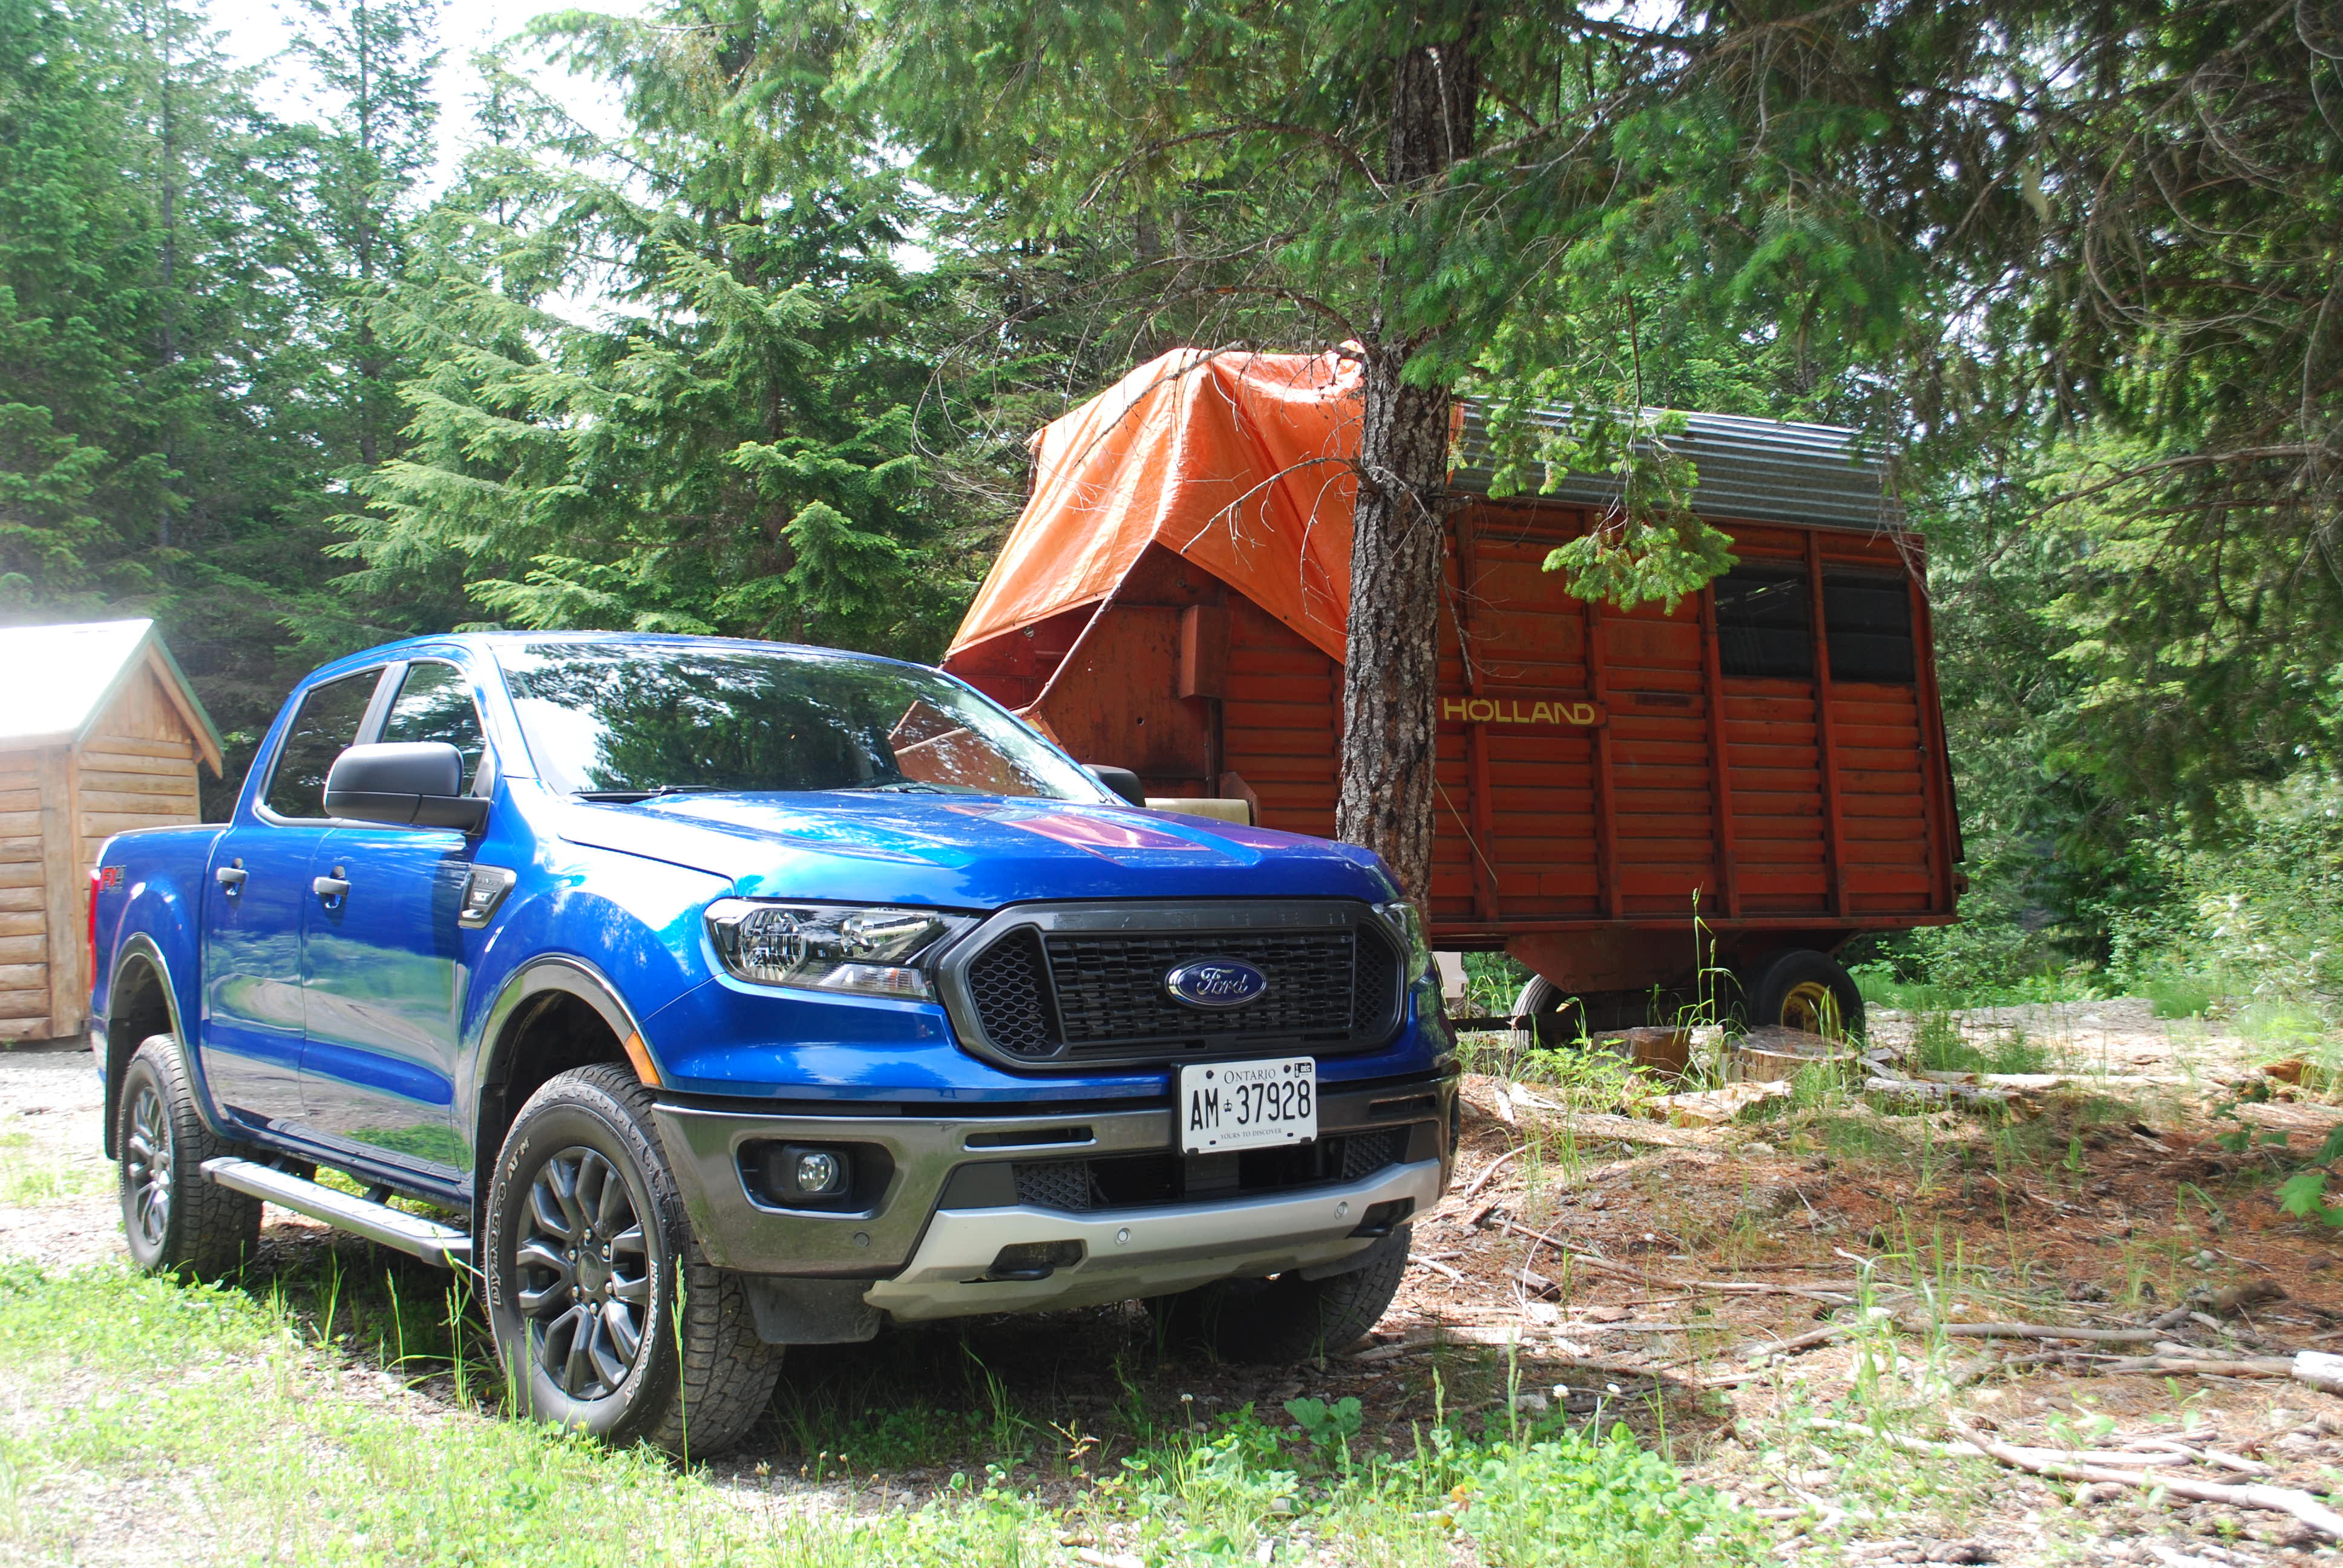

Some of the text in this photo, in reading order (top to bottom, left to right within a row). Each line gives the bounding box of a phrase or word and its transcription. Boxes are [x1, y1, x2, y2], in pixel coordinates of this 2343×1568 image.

[1443, 697, 1595, 725] HOLLAND
[100, 866, 126, 892] FX4
[1196, 968, 1248, 995] Ford
[1224, 1069, 1276, 1084] ONTARIO
[1190, 1079, 1311, 1131] AM 37928
[1253, 1128, 1282, 1137] DISCOVER
